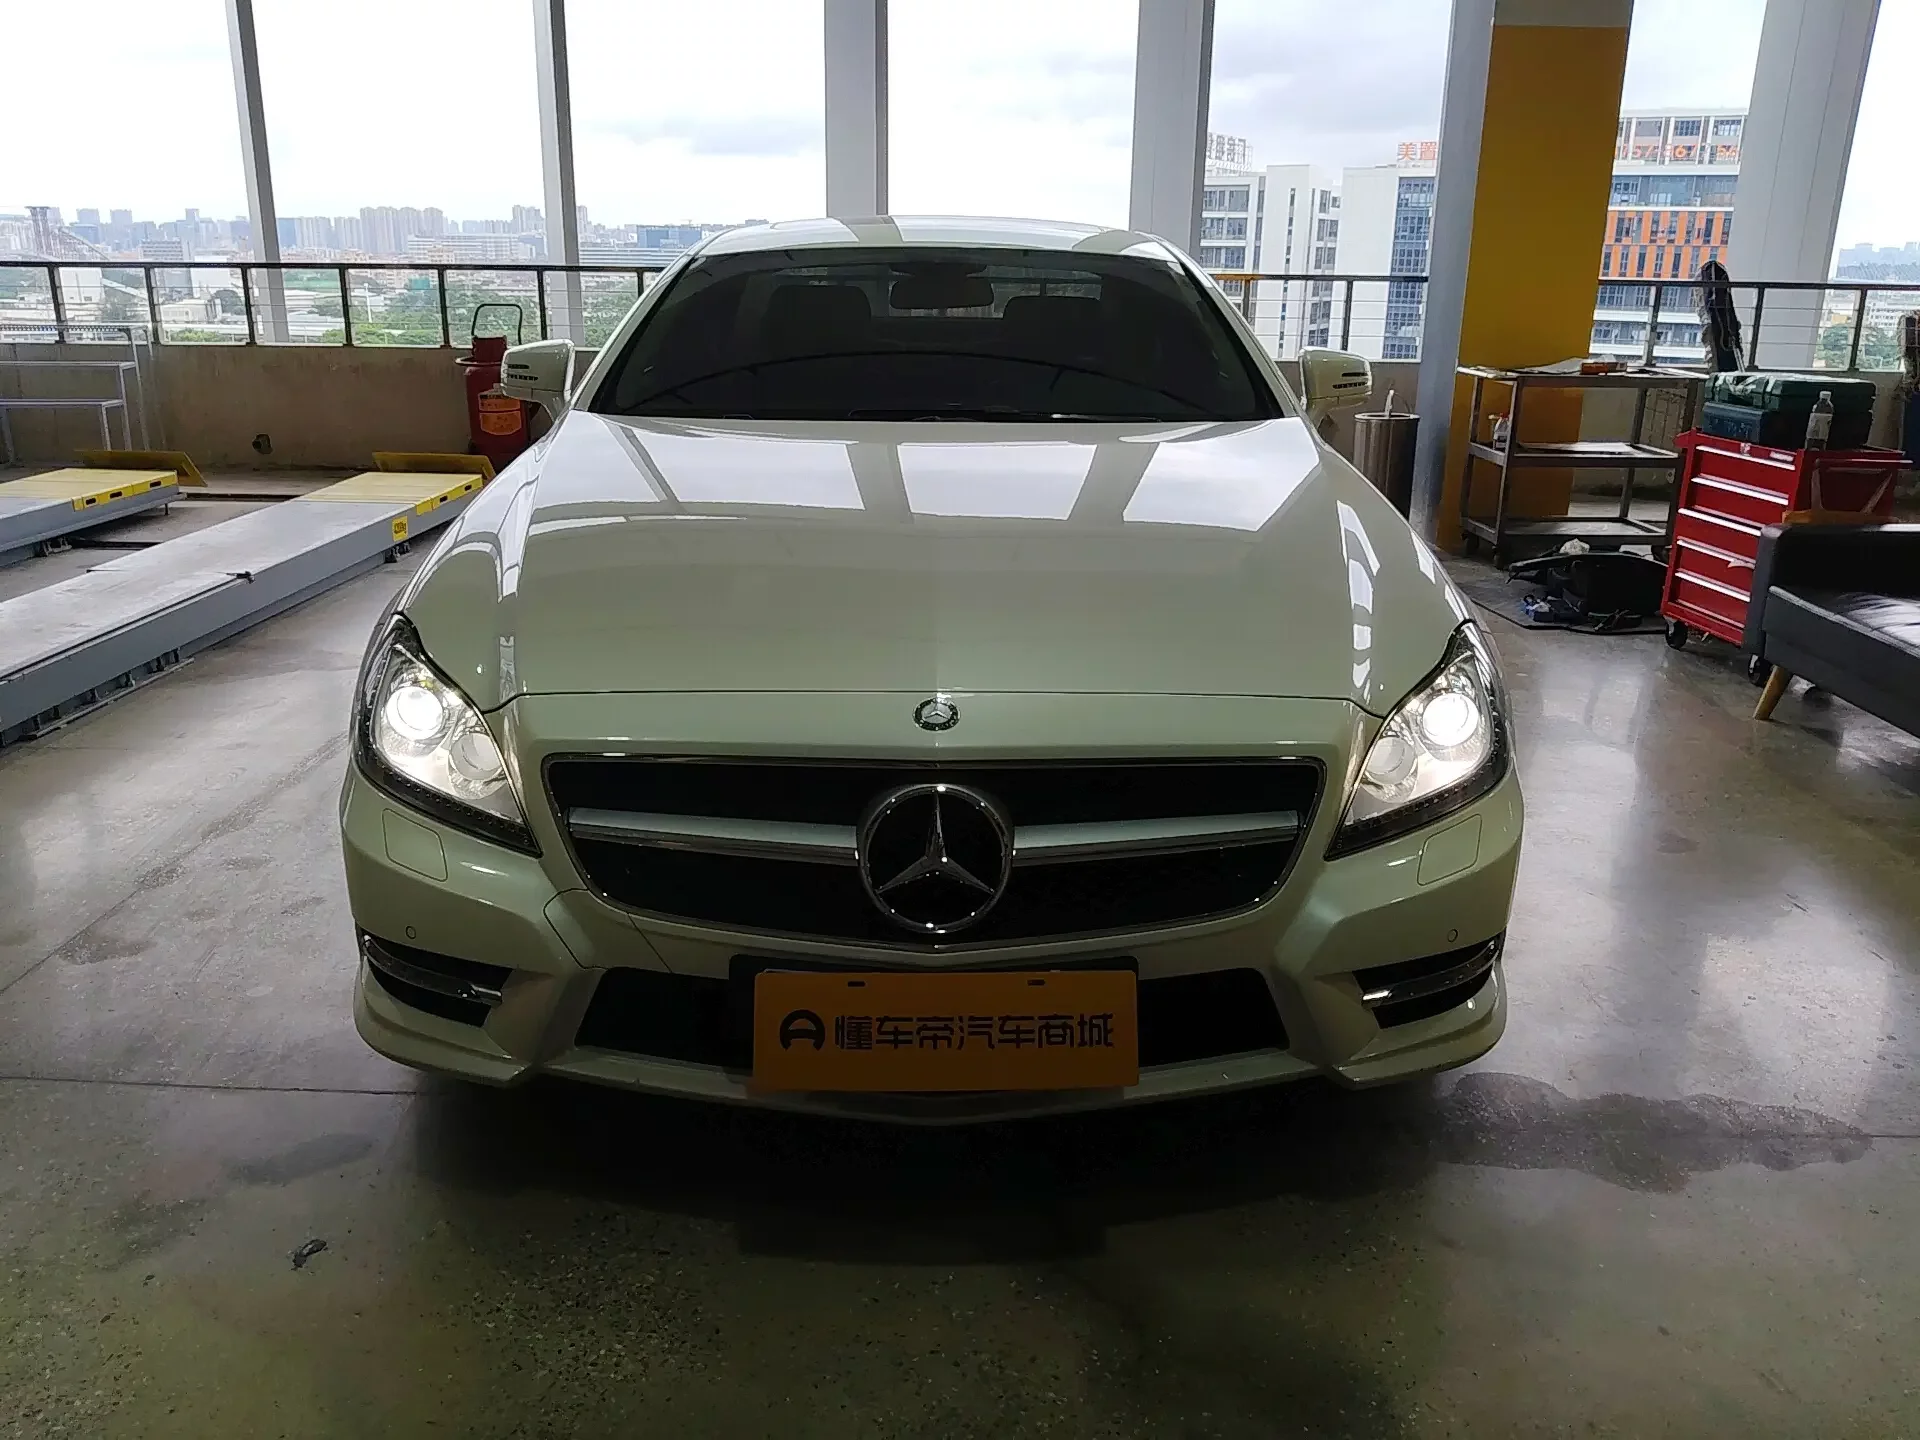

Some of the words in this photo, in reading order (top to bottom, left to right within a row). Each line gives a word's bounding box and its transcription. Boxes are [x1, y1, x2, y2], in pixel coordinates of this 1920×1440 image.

[834, 1012, 1115, 1051] 懂车帝汽车商城
